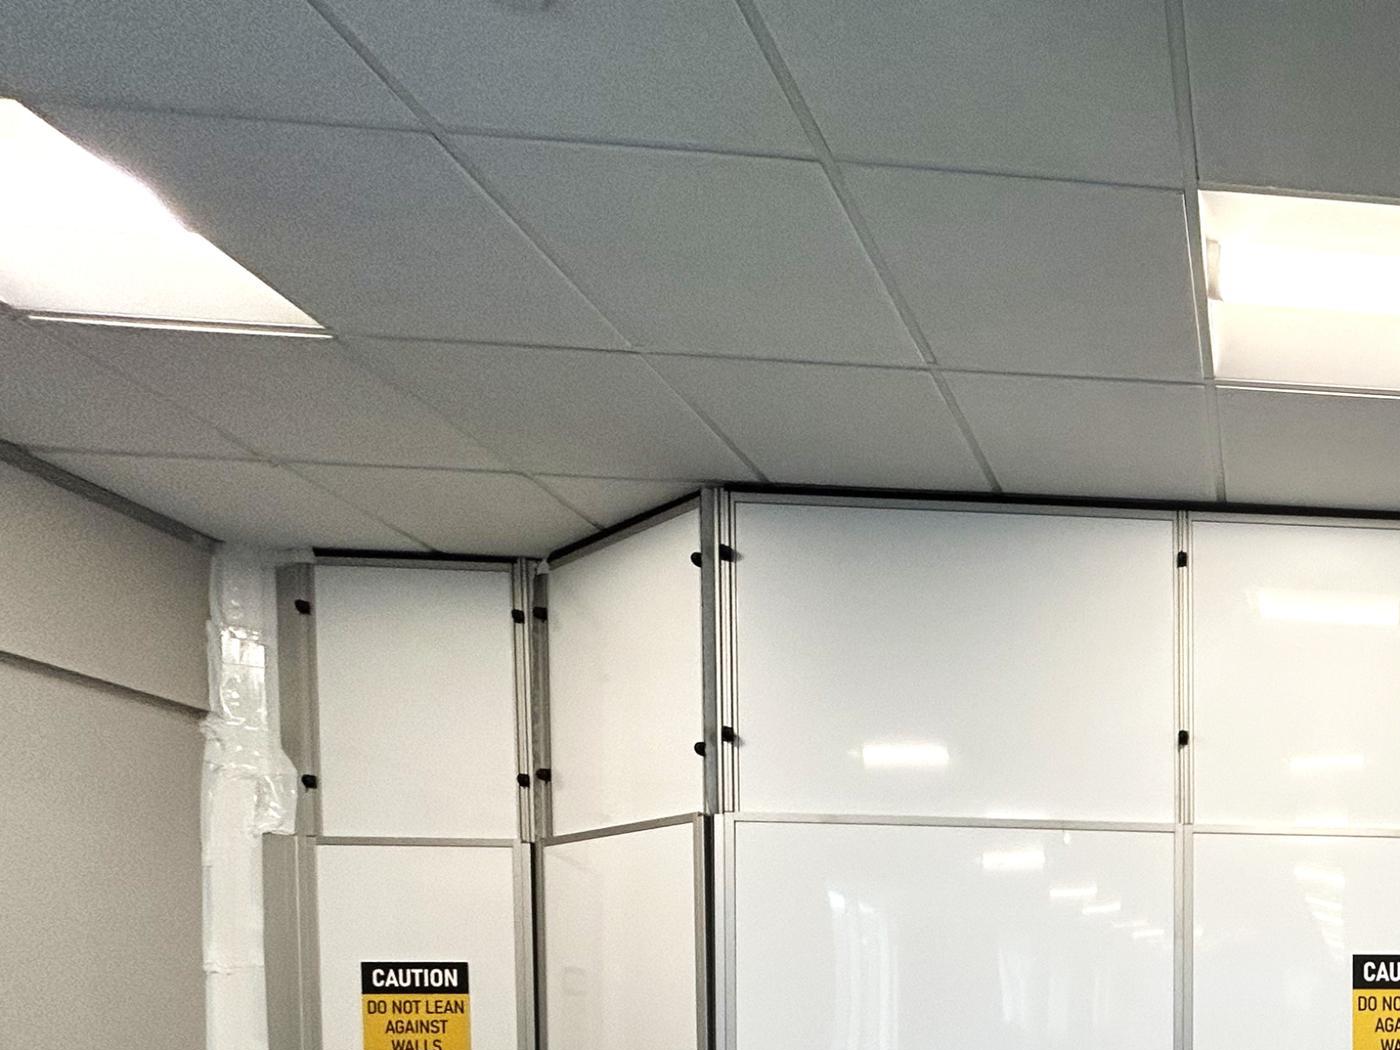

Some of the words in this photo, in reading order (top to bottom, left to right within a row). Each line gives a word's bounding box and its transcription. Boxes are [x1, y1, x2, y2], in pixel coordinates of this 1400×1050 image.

[372, 968, 458, 988] CAUTION
[367, 1000, 387, 1014] DO
[392, 1000, 421, 1014] NOT
[425, 1000, 464, 1014] LEAN
[1358, 996, 1377, 1011] DO
[385, 1019, 448, 1034] AGAINST
